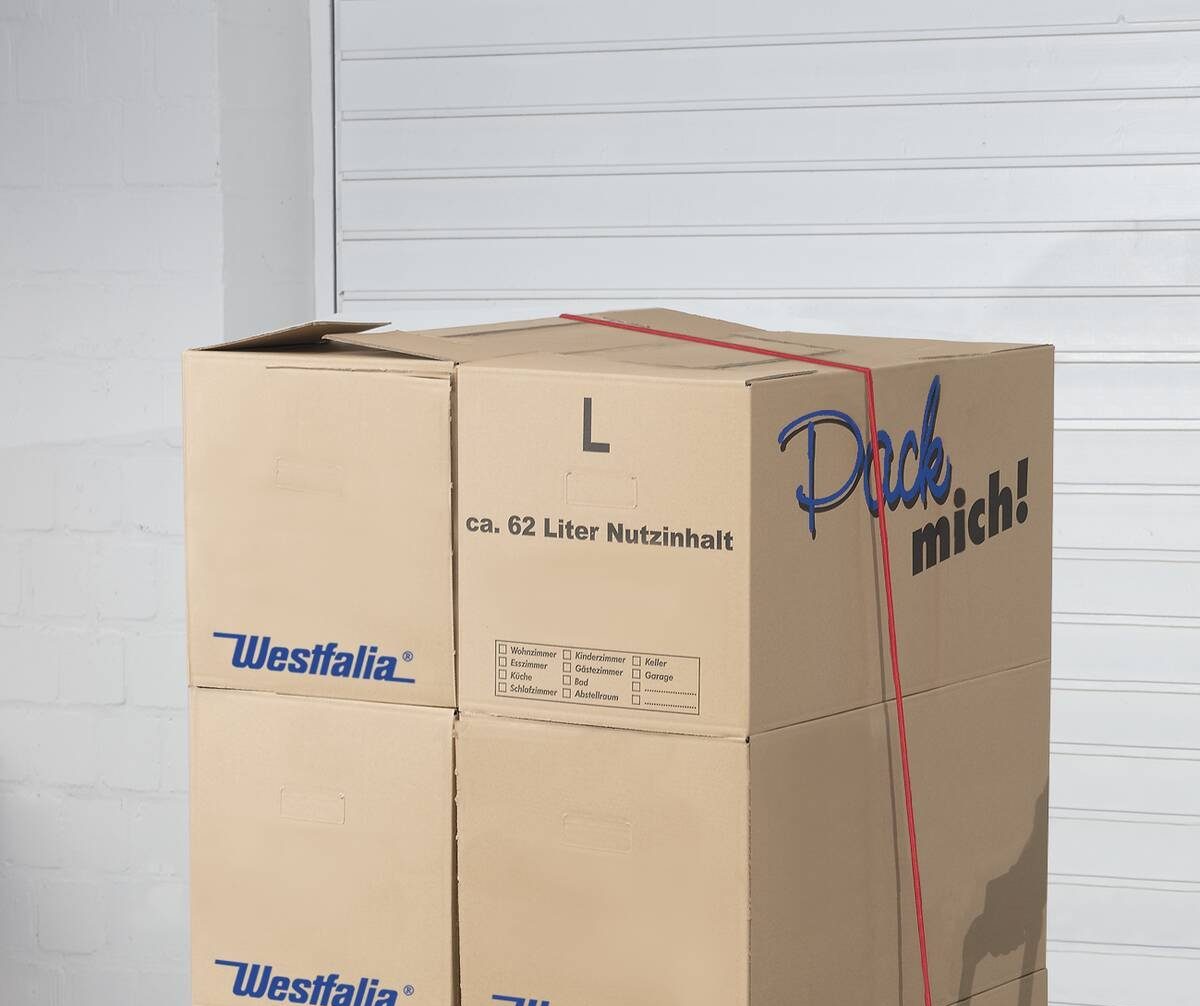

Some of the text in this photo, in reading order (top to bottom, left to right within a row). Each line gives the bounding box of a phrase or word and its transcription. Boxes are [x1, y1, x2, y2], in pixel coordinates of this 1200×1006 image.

[583, 397, 610, 453] L
[778, 374, 952, 541] Pack
[912, 457, 1029, 576] mich!
[465, 515, 734, 551] ca. 62 Liter Nutzinhalt
[510, 646, 557, 658] Wohnzimmer
[575, 652, 626, 664] Kinderzimmer
[510, 659, 548, 670] Esszimmer
[645, 658, 667, 667] Keller
[510, 671, 532, 682] Küche
[575, 664, 623, 677] Gästezimmer
[645, 671, 673, 682] Garage
[574, 678, 588, 687] Bad
[510, 684, 557, 696] Schlafzimmer
[574, 691, 619, 701] Abstellraum
